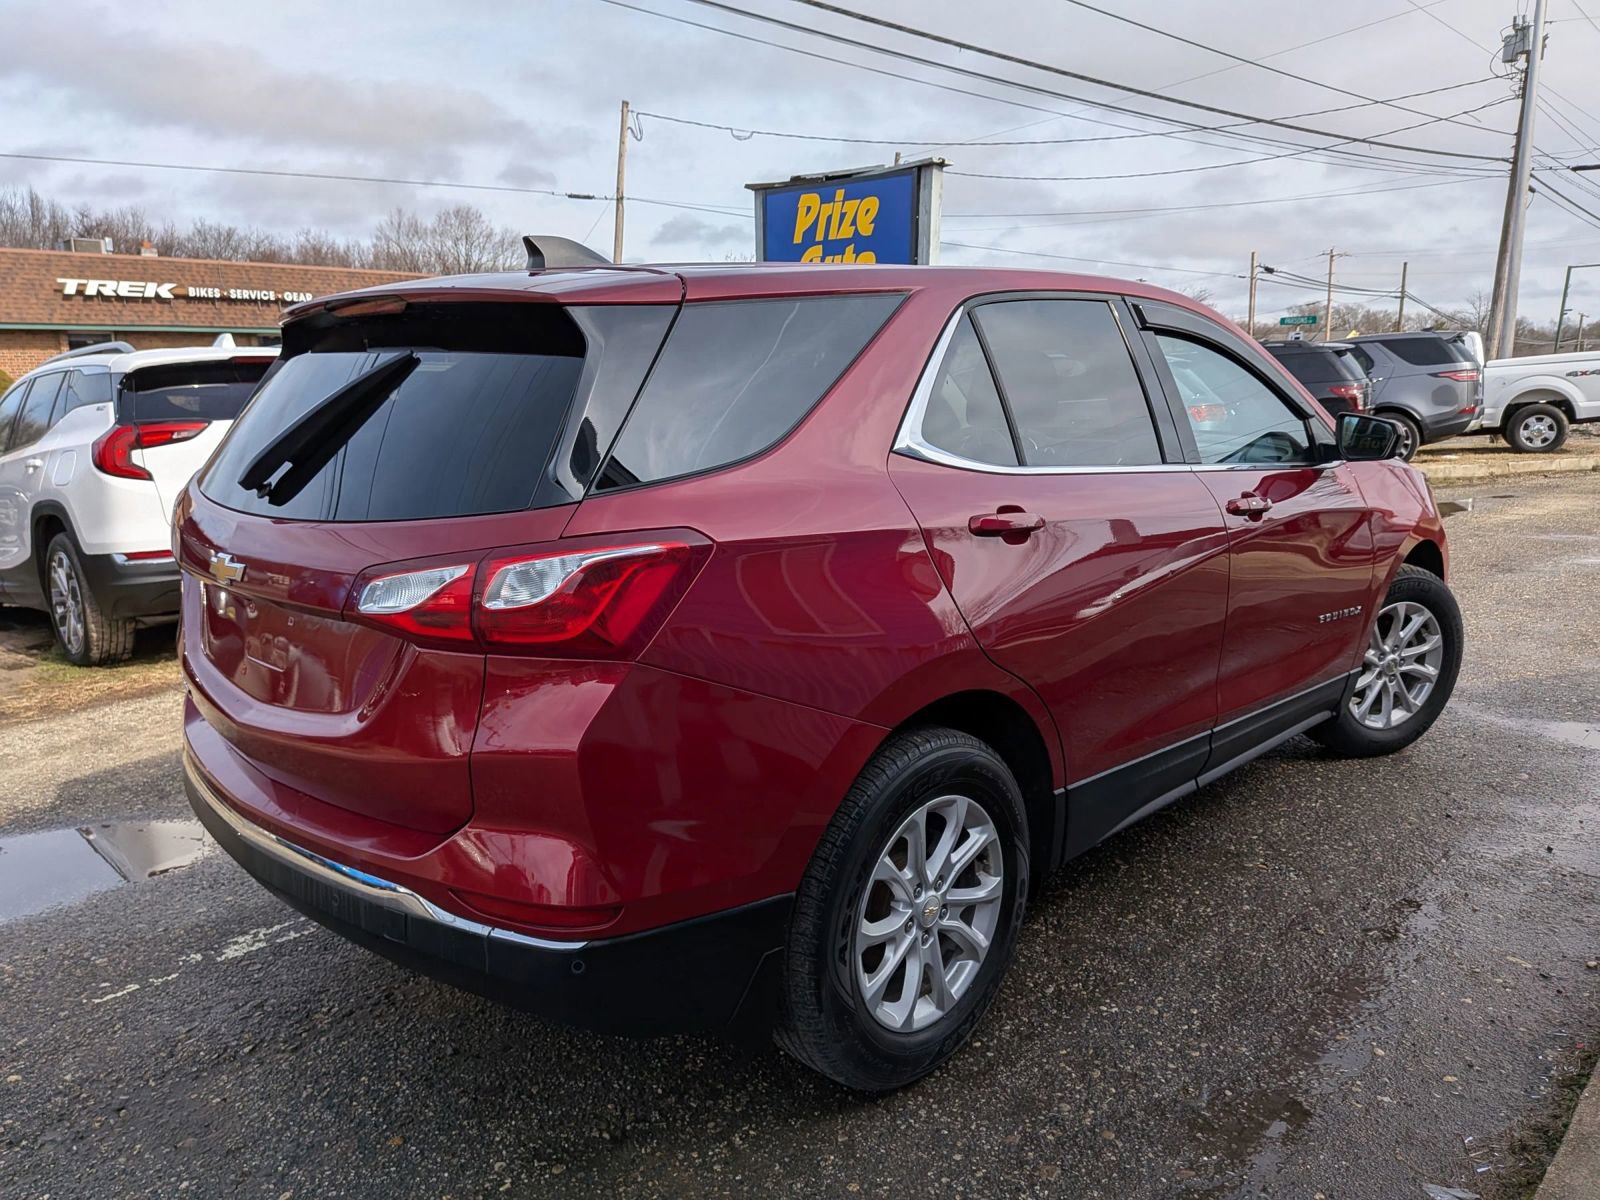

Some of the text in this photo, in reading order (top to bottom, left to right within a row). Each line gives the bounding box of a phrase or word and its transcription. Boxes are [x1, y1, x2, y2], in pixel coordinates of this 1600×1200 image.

[793, 189, 880, 244] Prize
[57, 278, 177, 299] TREK
[188, 287, 220, 298] BIKES
[229, 289, 276, 300] SERVICE
